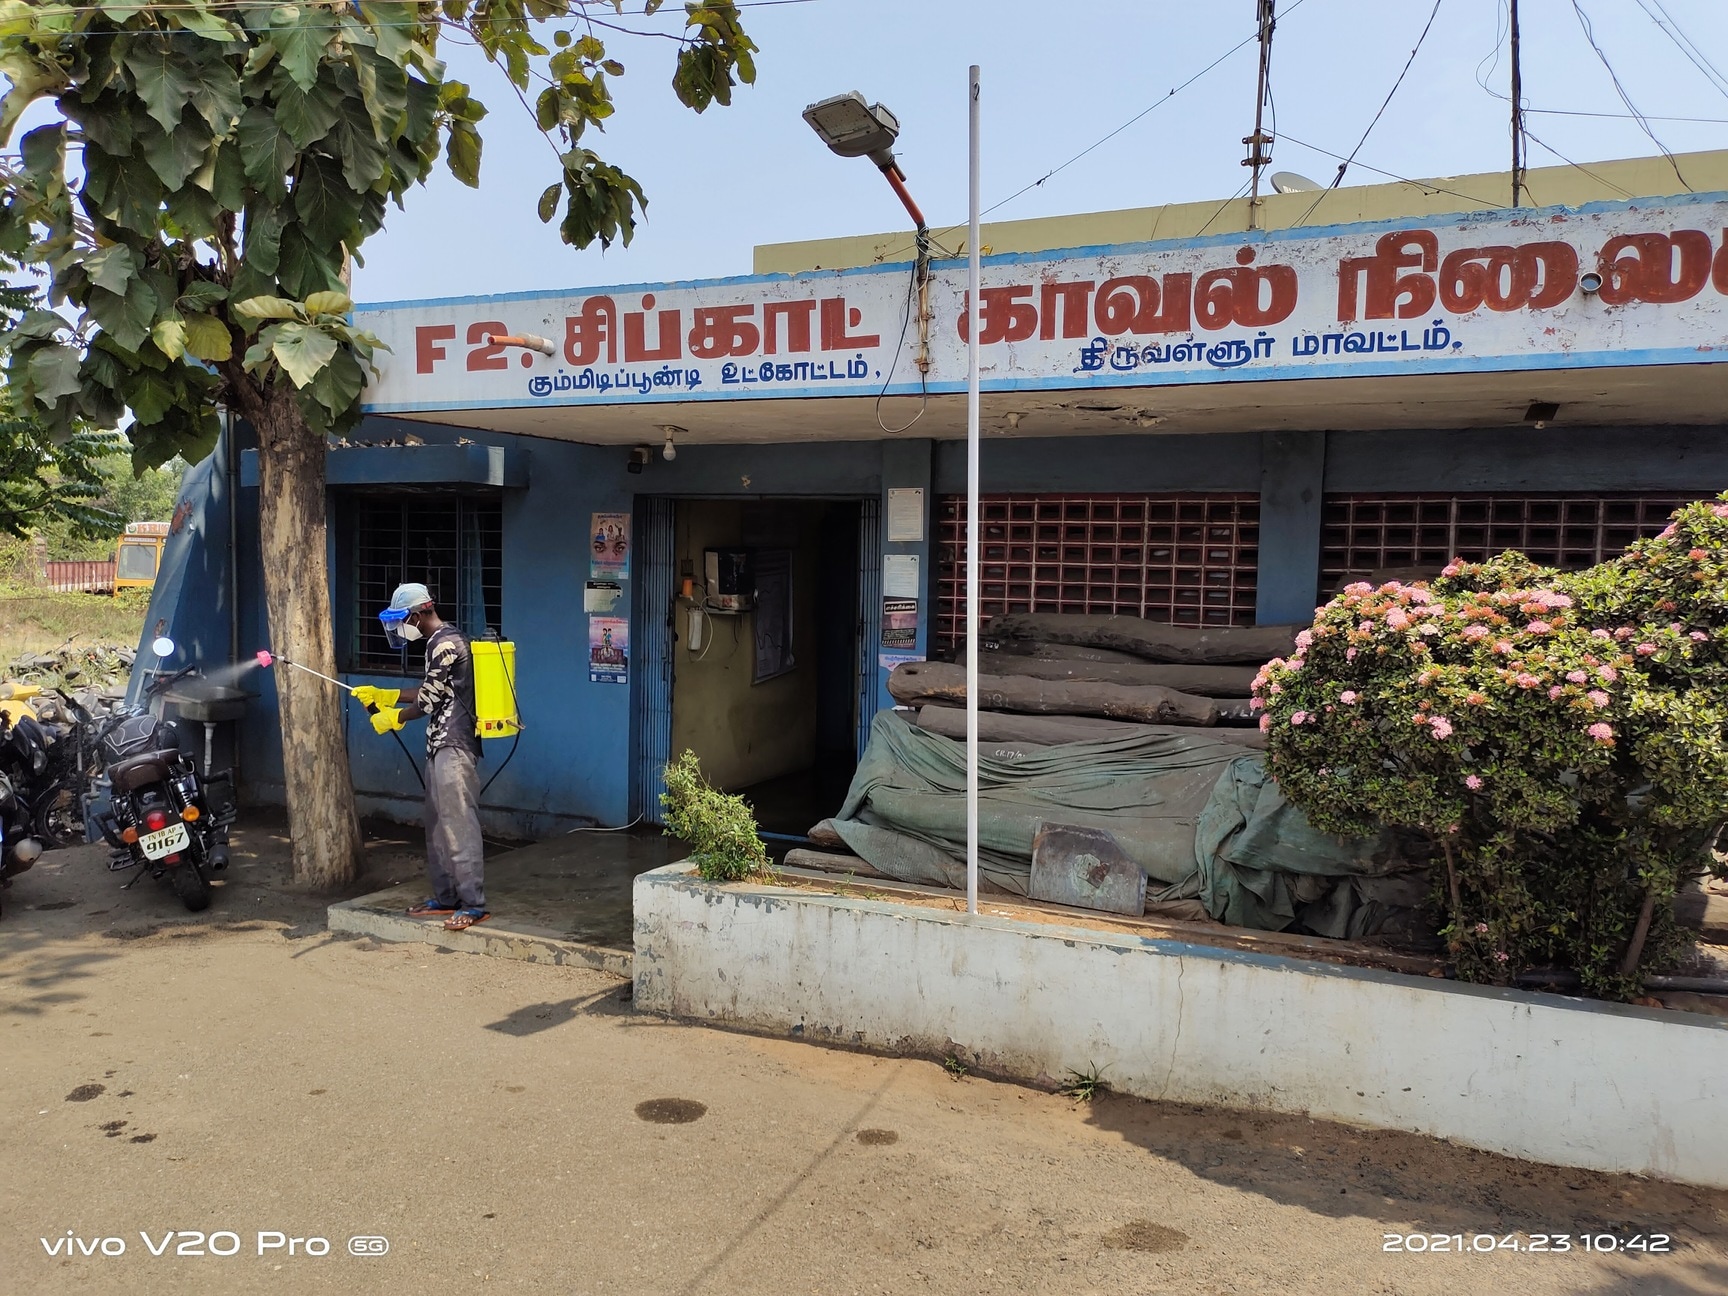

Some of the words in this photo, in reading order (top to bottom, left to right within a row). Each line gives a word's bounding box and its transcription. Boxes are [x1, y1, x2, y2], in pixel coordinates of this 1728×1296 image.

[563, 293, 880, 367] சிப்காட்
[957, 246, 1299, 345] காவல்
[1336, 229, 1728, 323] நிலை
[528, 365, 702, 397] கும்மிடிப்பூண்டி
[147, 832, 184, 854] 9167
